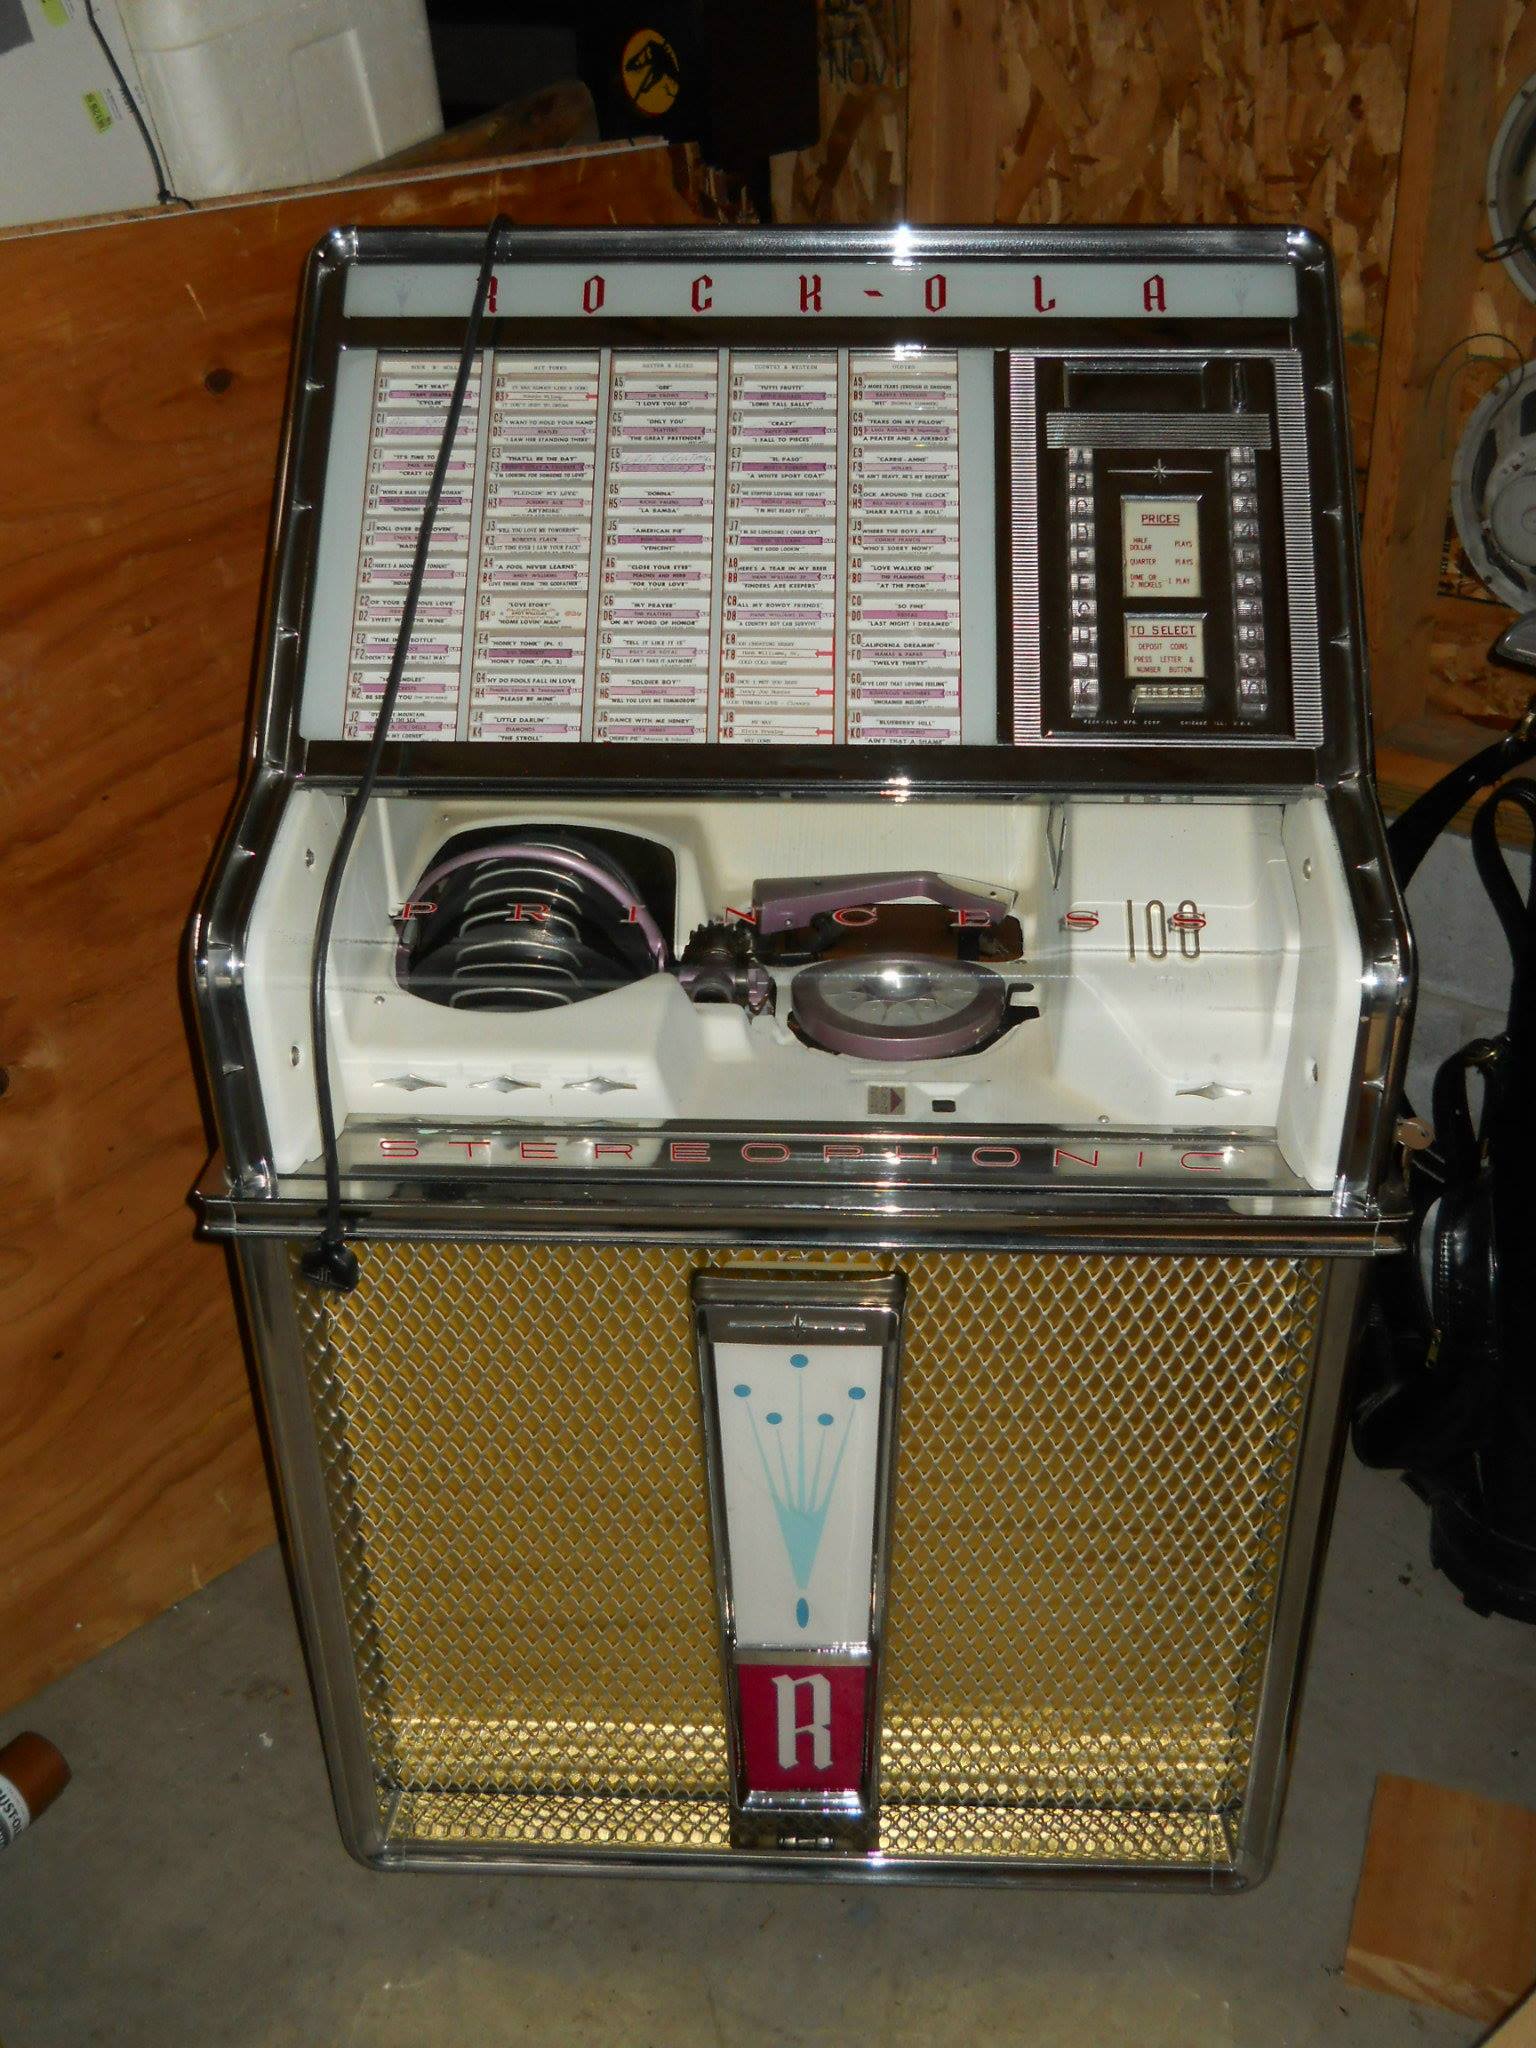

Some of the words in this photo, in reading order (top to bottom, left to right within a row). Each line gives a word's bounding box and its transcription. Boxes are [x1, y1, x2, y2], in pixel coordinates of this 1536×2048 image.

[1141, 513, 1181, 526] PRICES
[1174, 540, 1193, 548] PLAYS
[1129, 558, 1157, 566] QUARTER
[1175, 558, 1194, 566] PLAYS
[1130, 625, 1145, 636] TO
[1152, 625, 1197, 636] SELECT
[1134, 655, 1153, 663] PRESS
[1160, 655, 1182, 663] LETTER
[395, 901, 1207, 931] PRINCESS
[377, 1138, 1233, 1171] STEREOPHONIC
[772, 1673, 835, 1771] R
